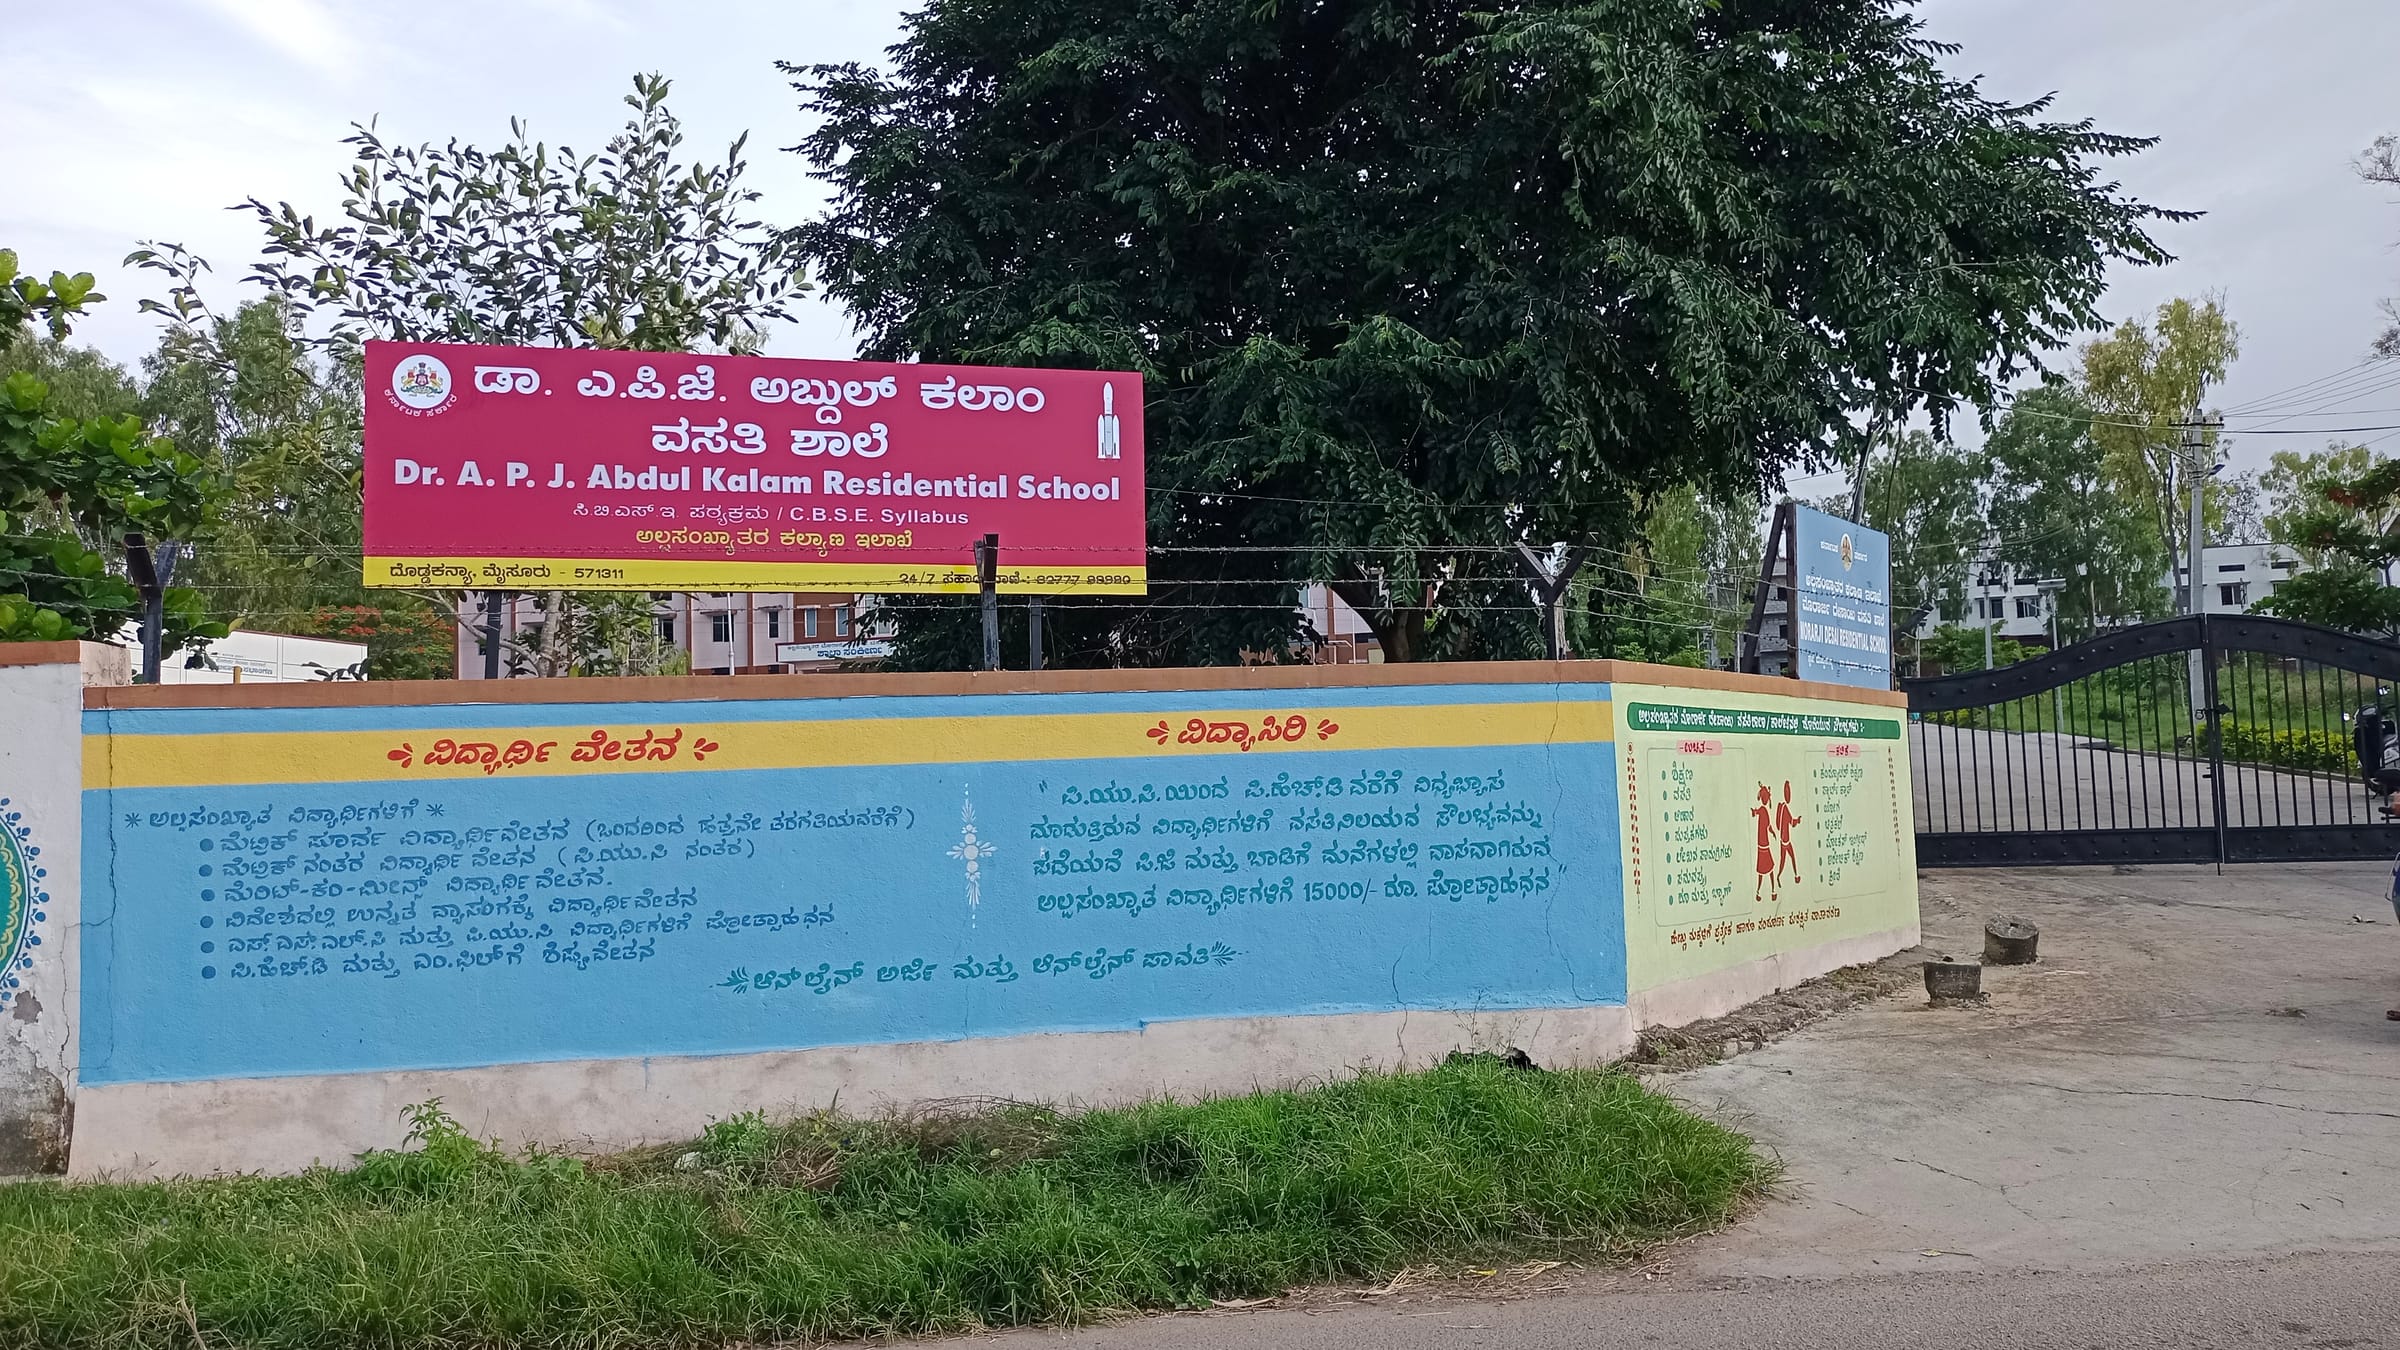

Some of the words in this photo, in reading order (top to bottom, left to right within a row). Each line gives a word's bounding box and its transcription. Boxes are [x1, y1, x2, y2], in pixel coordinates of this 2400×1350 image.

[474, 365, 552, 396] ಡಾ.
[577, 364, 727, 402] ಎ.ಪಿ.ಜೆ.
[750, 375, 898, 425] ಅಬ್ದುಲ್
[920, 376, 1046, 413] ಕಲಾಂ
[651, 416, 767, 455] ವಸತಿ
[790, 422, 890, 458] ಶಾಲೆ
[394, 459, 445, 486] Dr.
[456, 460, 495, 487] A.
[506, 462, 536, 488] P.
[547, 463, 575, 489] J.
[587, 463, 690, 491] Abdul
[702, 467, 812, 494] Kalam
[823, 470, 1007, 499] Residential
[1017, 475, 1120, 501] School
[790, 507, 873, 524] C.B.S.E.
[881, 508, 969, 527] Syllabus
[780, 529, 845, 558] ಕಲ್ಯಾಣ
[855, 529, 913, 549] ಇಲಾಖೆ
[482, 563, 551, 584] ಮೈಸೂರು
[574, 568, 624, 579] 571311
[899, 571, 935, 587] 24/7
[1800, 620, 1824, 644] MORARJI
[1824, 625, 1839, 646] DESAI
[1839, 628, 1869, 652] RESIDENTIAL
[1869, 634, 1888, 655] SCHOOL
[570, 727, 682, 762] ವೇತನ
[1177, 715, 1308, 752] ವಿದ್ಯಾಸಿರಿ
[304, 851, 365, 875] ನಂತರ
[472, 845, 536, 868] ವೇತನ
[1185, 845, 1239, 874] ಮತ್ತು
[1247, 841, 1312, 867] ಬಾಡಿಗೆ
[1303, 878, 1377, 904] 15000/-
[400, 925, 454, 948] ಮತ್ತು
[343, 951, 401, 979] ಮತ್ತು
[952, 953, 1019, 982] ಮತ್ತು
[1143, 943, 1209, 969] ಪಾವತಿ
